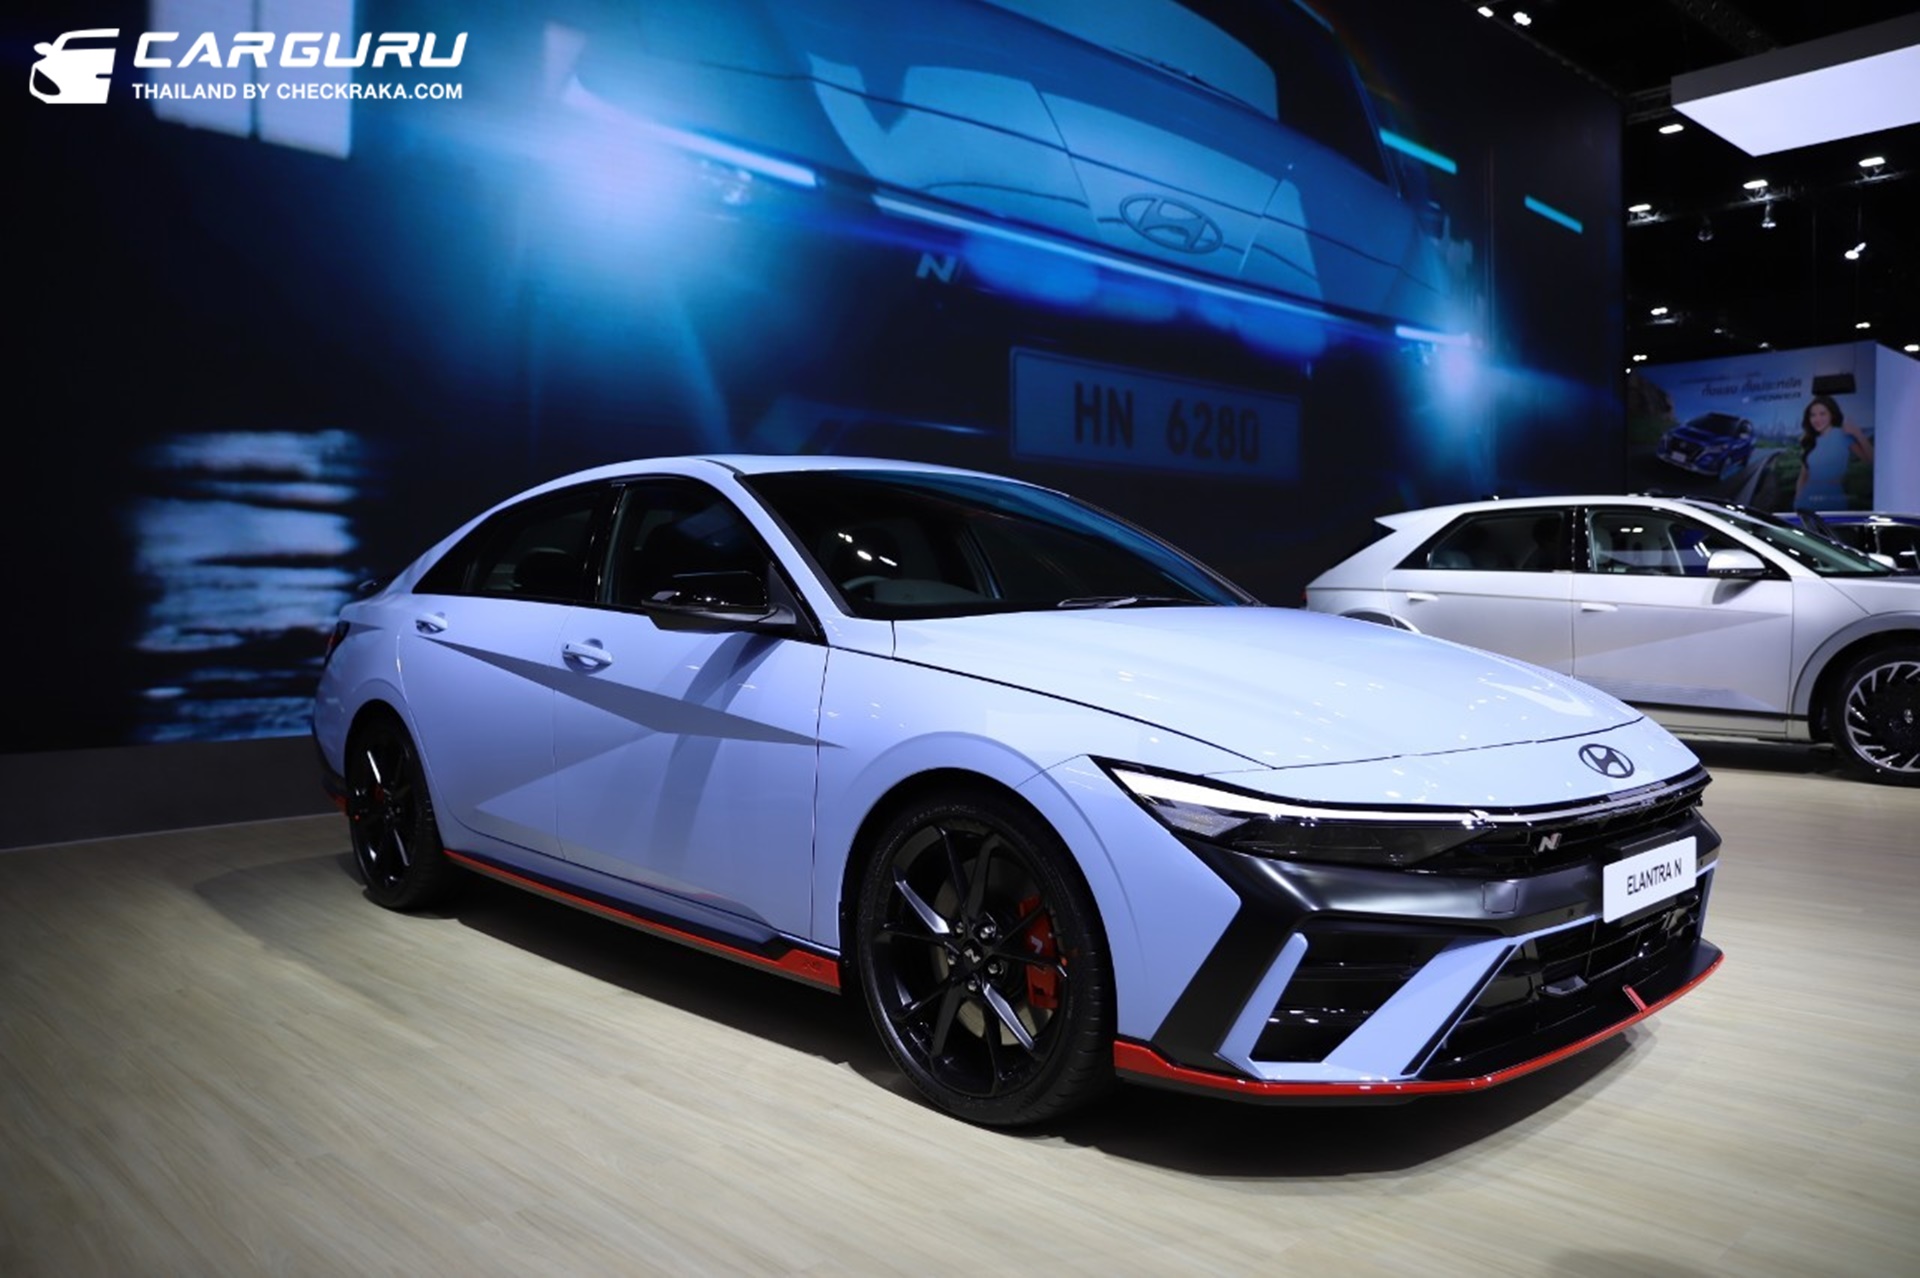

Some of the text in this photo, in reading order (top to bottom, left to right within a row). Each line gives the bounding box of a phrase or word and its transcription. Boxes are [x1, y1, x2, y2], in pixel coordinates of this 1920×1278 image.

[916, 252, 957, 283] N
[1073, 381, 1261, 464] HN 6280
[1538, 832, 1562, 852] N
[1626, 857, 1683, 896] ELANTRA N
